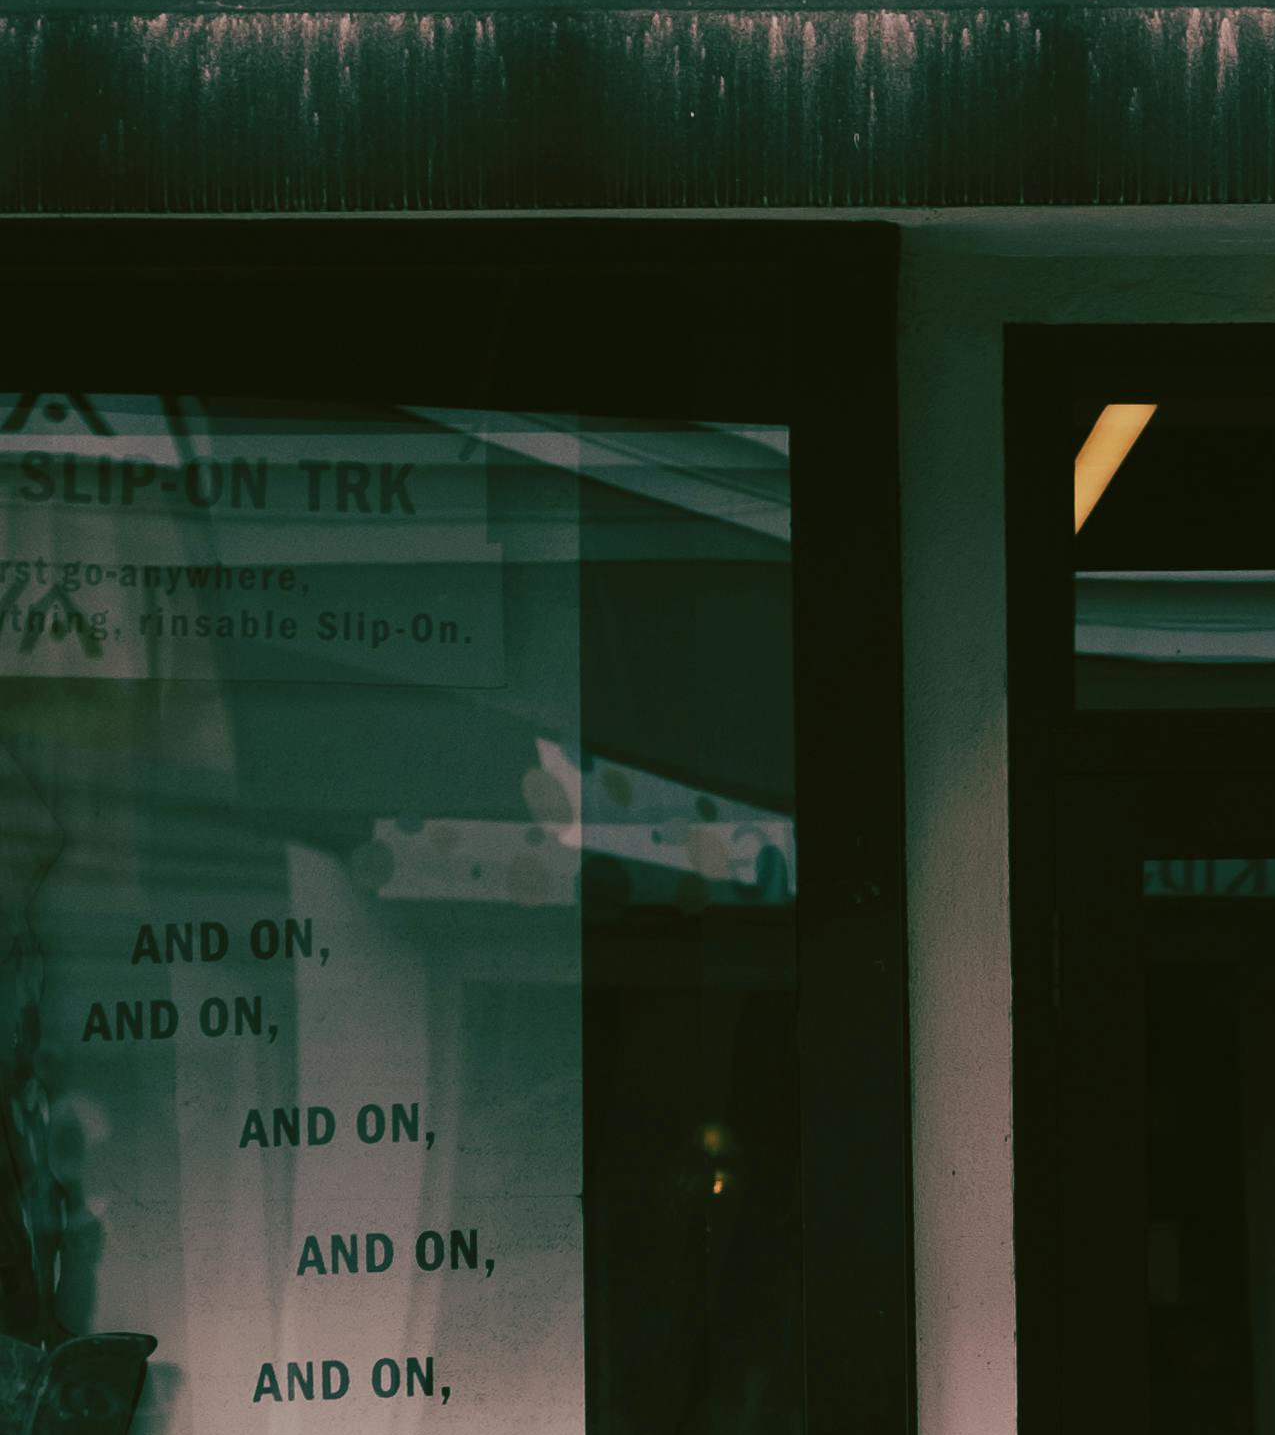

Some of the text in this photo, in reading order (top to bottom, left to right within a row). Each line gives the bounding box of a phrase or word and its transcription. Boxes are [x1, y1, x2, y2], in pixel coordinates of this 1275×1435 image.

[19, 450, 417, 516] SLIP-ON TRK
[62, 559, 310, 597] go-anywhere,
[139, 608, 298, 639] rinsable
[316, 611, 472, 648] Slip-On.
[131, 917, 331, 965] AND ON,
[82, 996, 279, 1044] AND ON,
[238, 1102, 436, 1150] AND ON,
[296, 1228, 495, 1279] AND ON,
[252, 1356, 451, 1406] AND ON,
